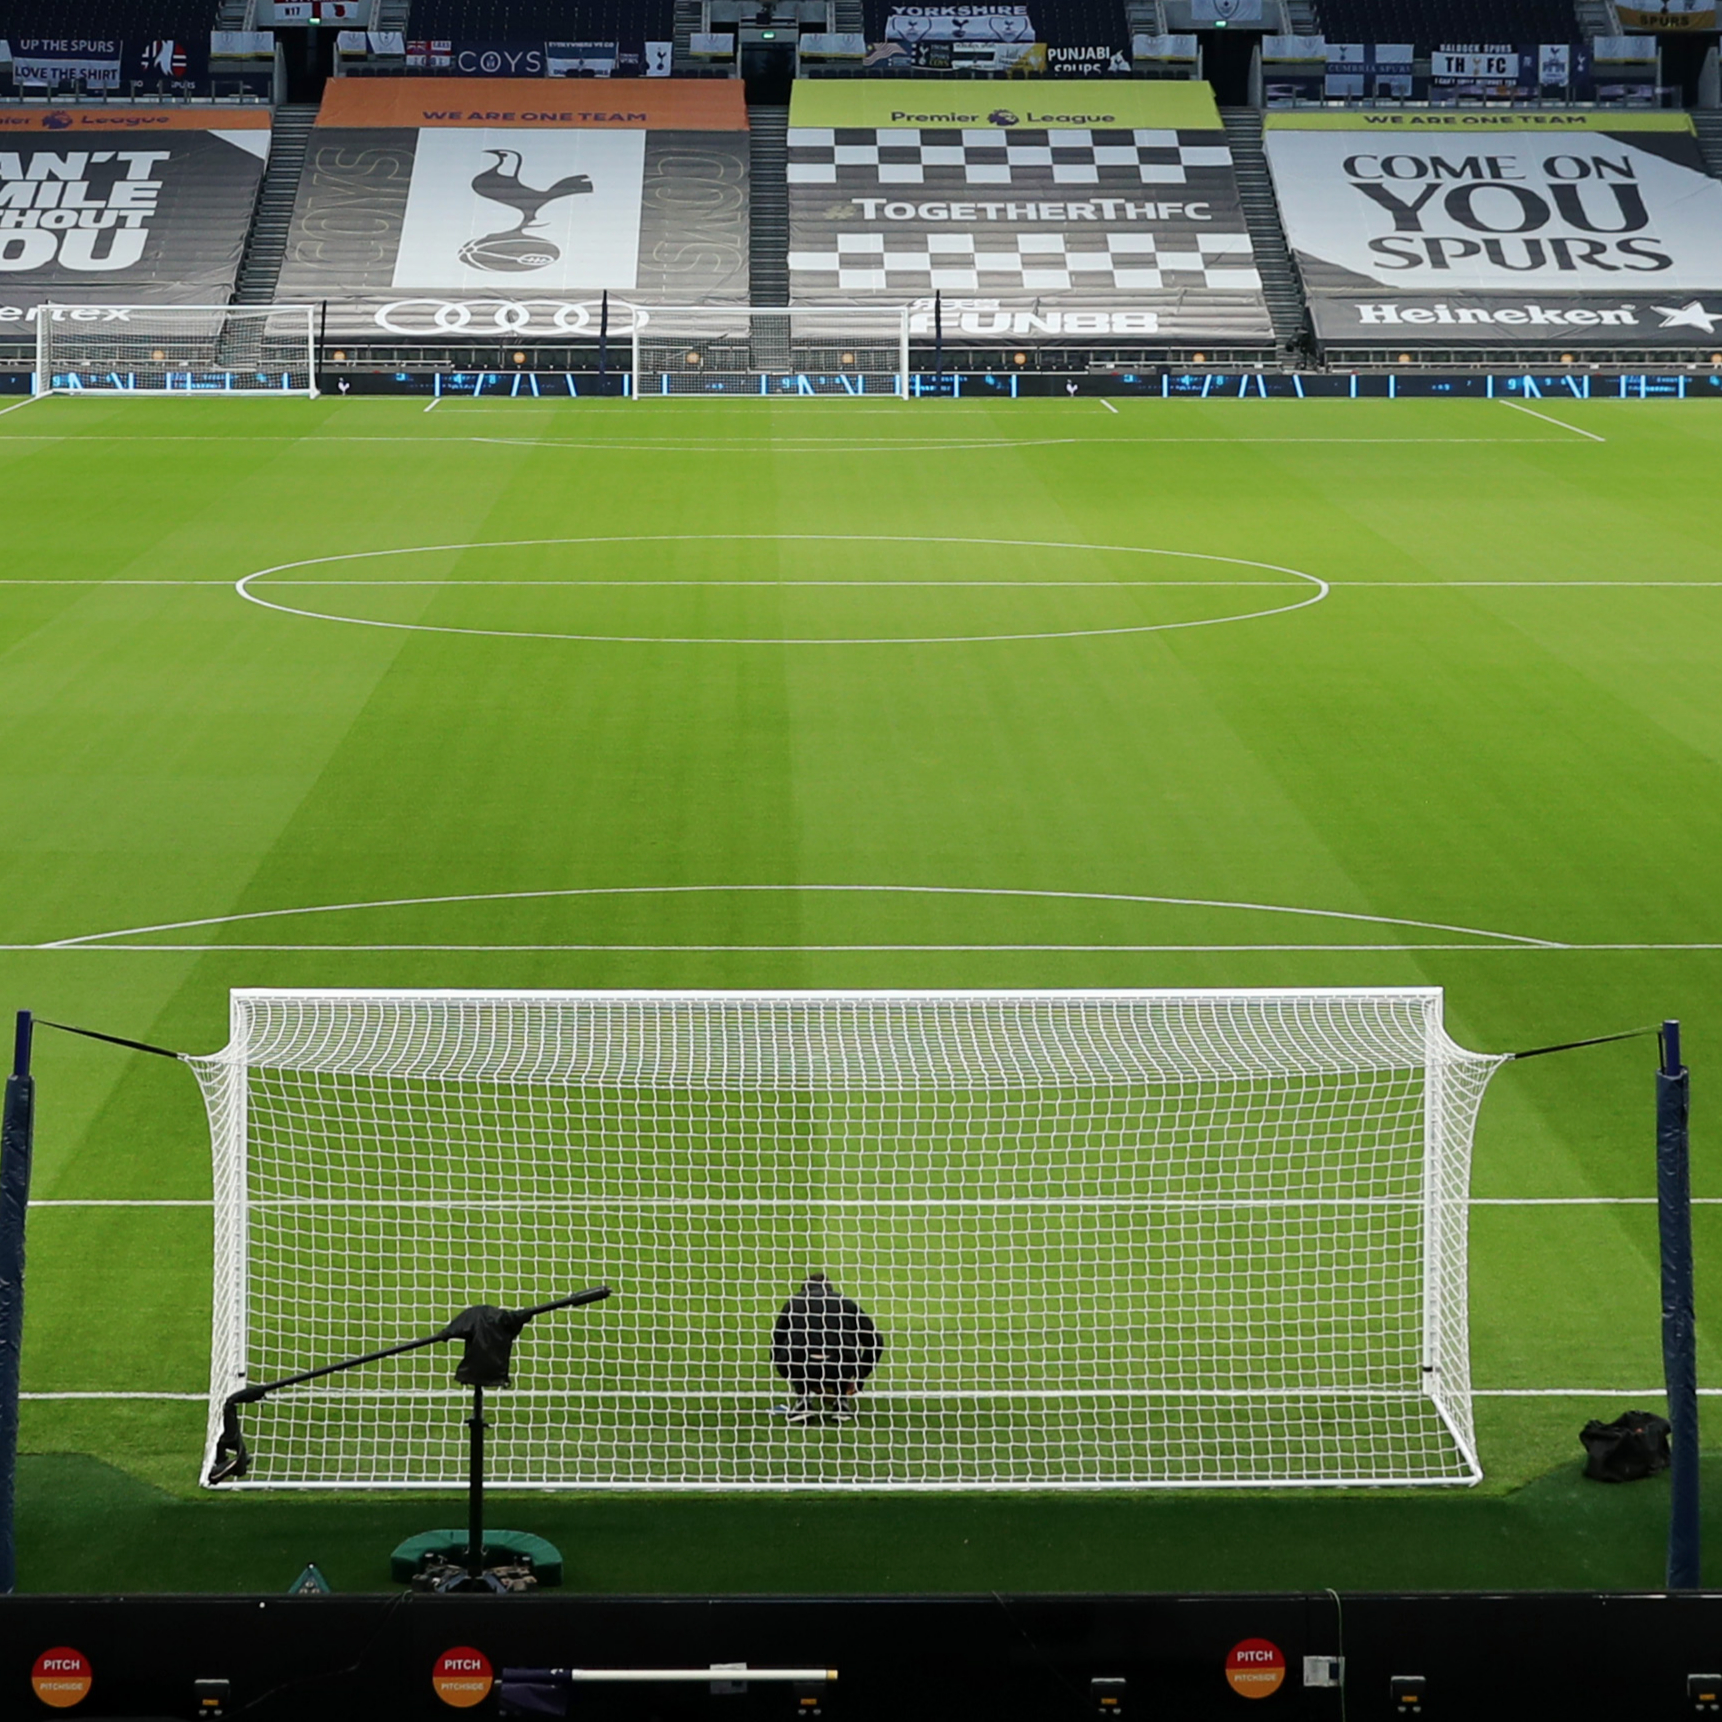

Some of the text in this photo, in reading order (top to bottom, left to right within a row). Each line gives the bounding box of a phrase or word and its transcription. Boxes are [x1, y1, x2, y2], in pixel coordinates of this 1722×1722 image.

[892, 6, 1028, 17] YORKSHIRE
[1640, 15, 1690, 27] SPURS
[20, 38, 115, 53] UP THE SPURS
[457, 49, 541, 73] COYS
[1047, 46, 1111, 62] PUNJABI
[1328, 65, 1412, 74] CUMBRIA SPURS
[1446, 57, 1506, 73] TH FC
[15, 66, 118, 80] LOVE THE SHIRT
[81, 114, 170, 126] League
[423, 111, 647, 122] WE ARE ONE TEAM
[891, 111, 1116, 125] Premier League
[1364, 114, 1587, 125] WE ARE ONE TEAM
[1343, 154, 1635, 179] COME ON
[1351, 182, 1649, 234] YOU
[1368, 237, 1674, 272] SPURS
[1356, 304, 1640, 326] Heineken
[910, 312, 1159, 334] FUN88
[1237, 1650, 1274, 1663] PITCH
[43, 1659, 81, 1671] PITCH
[444, 1659, 481, 1671] PITCH
